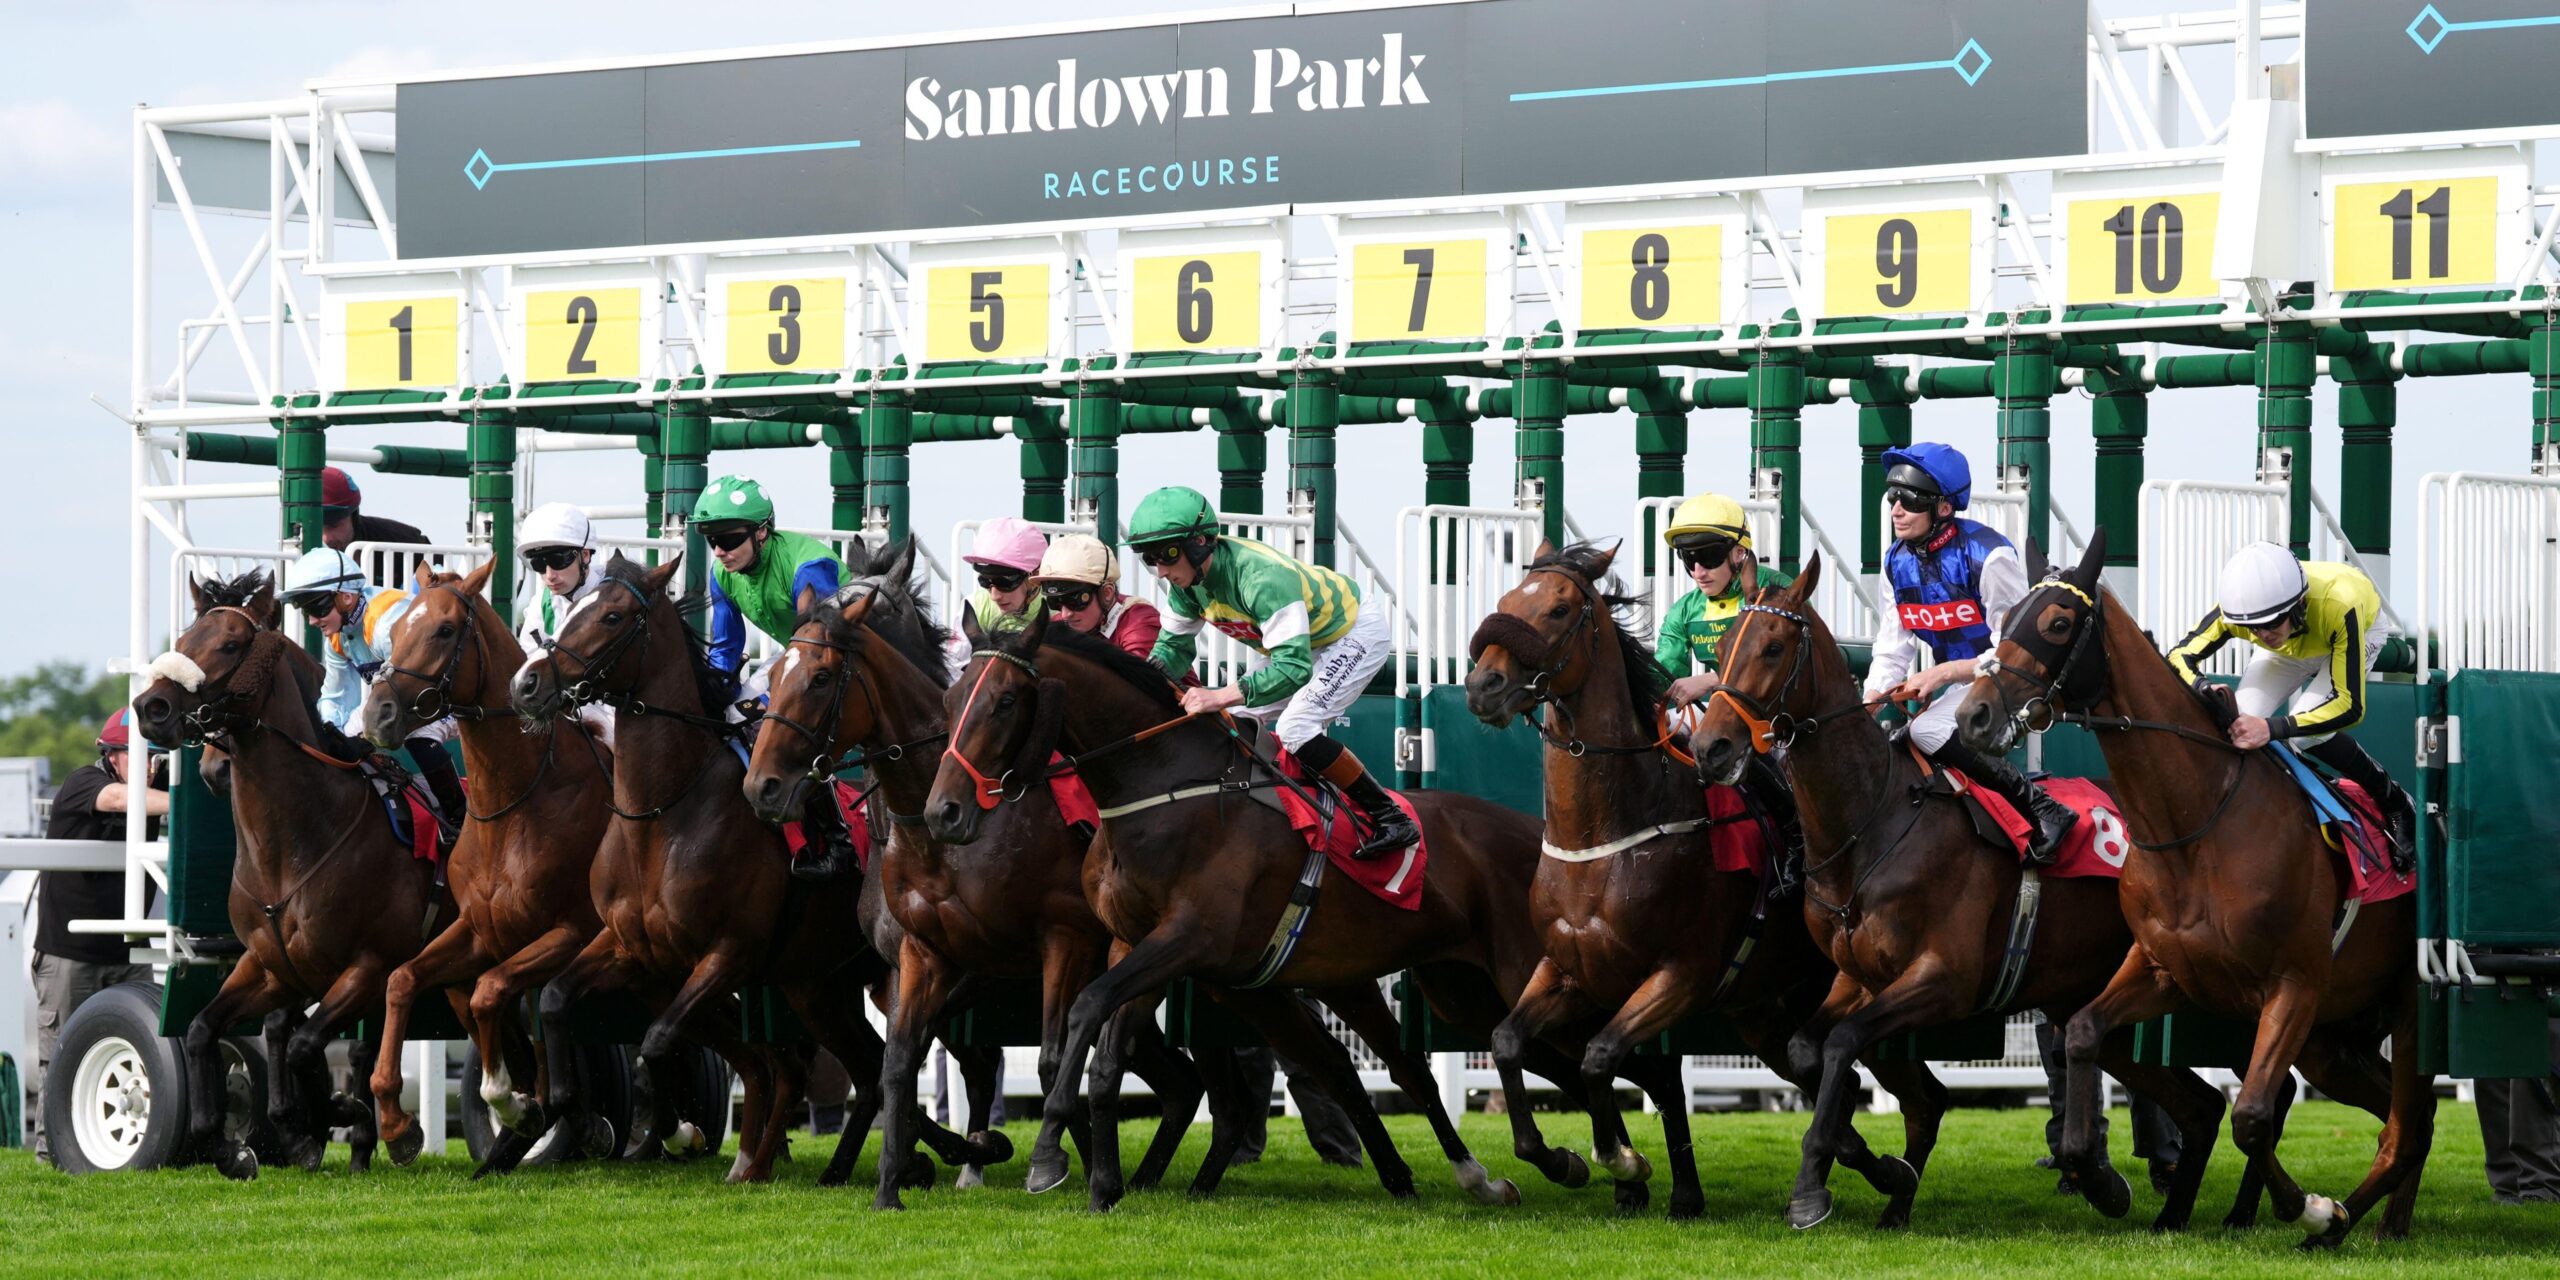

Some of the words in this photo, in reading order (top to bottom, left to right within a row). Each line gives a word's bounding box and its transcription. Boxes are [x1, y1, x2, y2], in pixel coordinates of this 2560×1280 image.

[905, 58, 1230, 141] Sandown
[1250, 32, 1431, 114] Park
[1044, 154, 1280, 199] RACECOURSE
[1876, 219, 1918, 308] 9
[2103, 202, 2183, 294] 10
[2380, 187, 2450, 280] 11
[970, 272, 1004, 353] 5
[1177, 260, 1213, 344] 6
[1404, 249, 1434, 332] 7
[1630, 234, 1670, 321] 8
[390, 306, 412, 381] 1
[566, 297, 598, 374] 2
[768, 285, 801, 366] 3
[1709, 622, 1727, 633] The
[1903, 603, 1976, 627] tote
[1318, 652, 1349, 687] Ashby
[1322, 651, 1363, 702] Underwriting
[2091, 806, 2130, 869] 8
